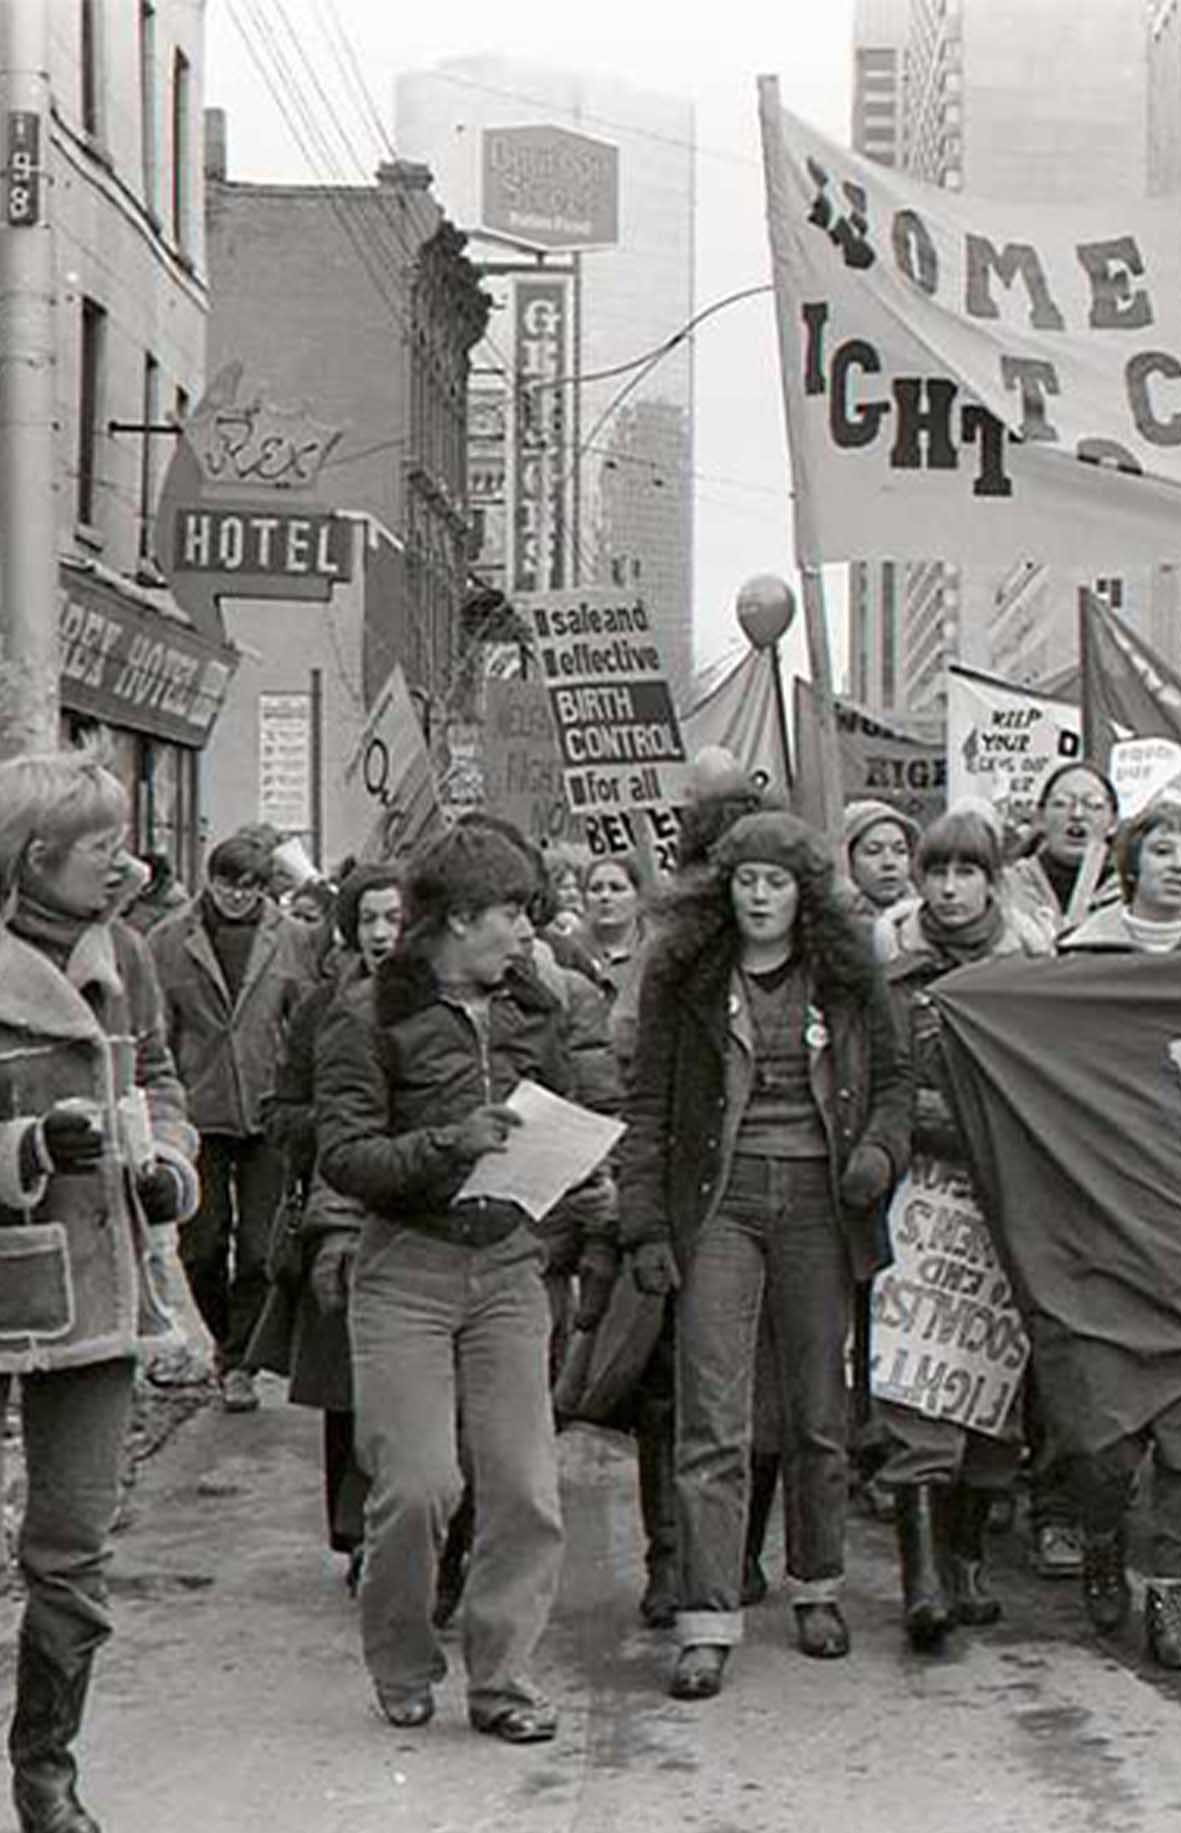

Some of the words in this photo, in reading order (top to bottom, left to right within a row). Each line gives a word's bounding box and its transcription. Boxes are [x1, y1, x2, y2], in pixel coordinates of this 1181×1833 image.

[801, 302, 1026, 497] IGHT
[205, 405, 319, 480] Rex
[185, 515, 339, 572] HOTEL
[551, 602, 602, 636] safe
[602, 599, 648, 632] and
[560, 639, 660, 676] effective
[556, 687, 635, 724] BIRTH
[991, 707, 1043, 728] KEEP
[565, 723, 683, 762] CONTROL
[981, 732, 1031, 752] YOUR
[586, 771, 621, 804] for
[629, 767, 662, 802] all
